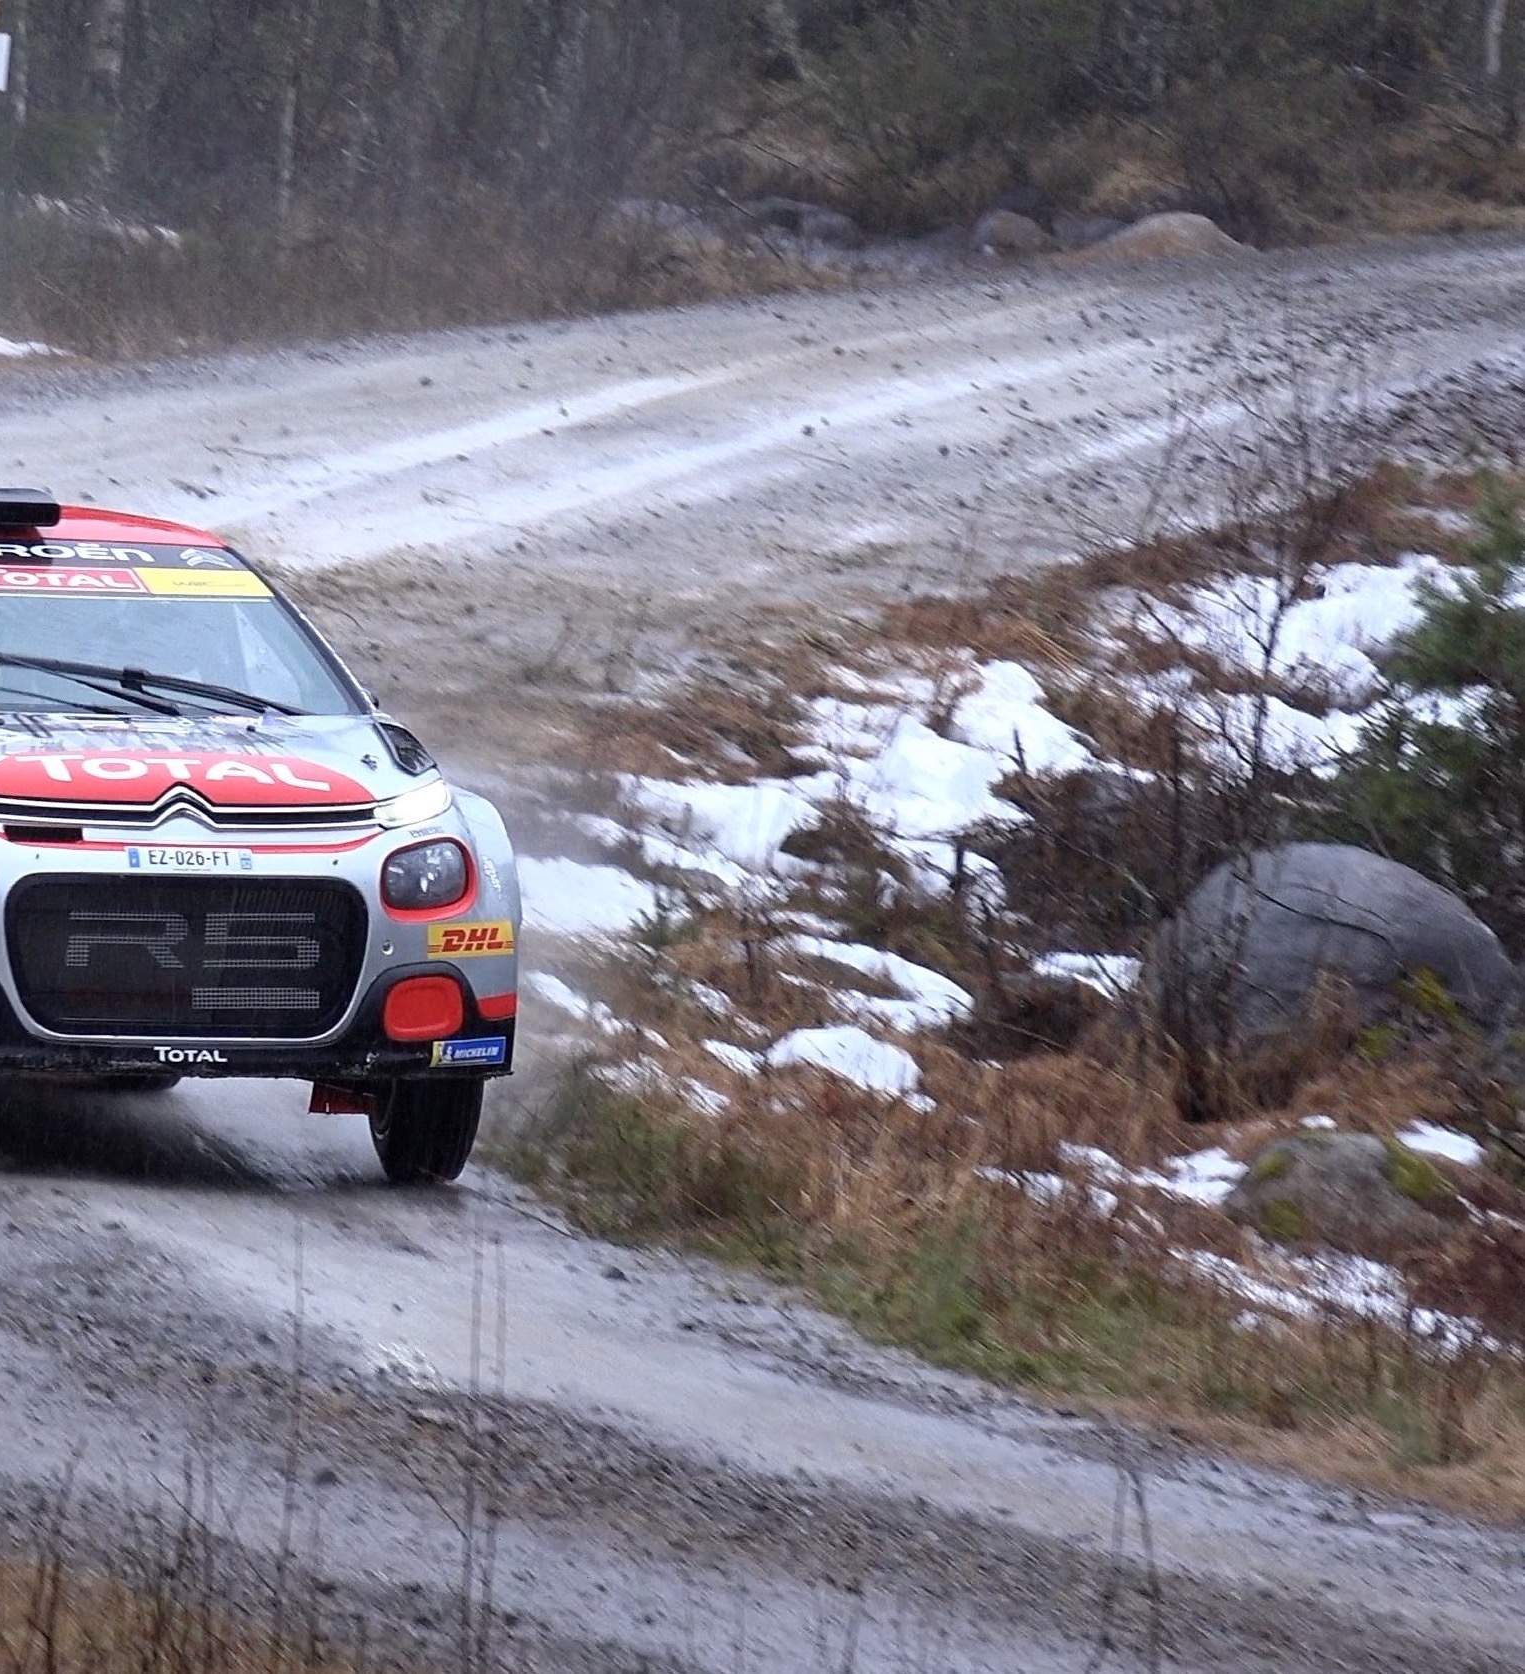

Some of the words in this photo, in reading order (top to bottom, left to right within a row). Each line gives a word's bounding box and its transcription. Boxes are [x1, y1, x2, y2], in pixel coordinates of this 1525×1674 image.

[15, 754, 331, 791] TOTAL
[148, 850, 230, 866] EZ-026-FT
[67, 912, 320, 968] R5
[442, 927, 504, 952] DHL
[153, 1046, 228, 1062] TOTAL
[453, 1046, 500, 1060] MICHELIN
